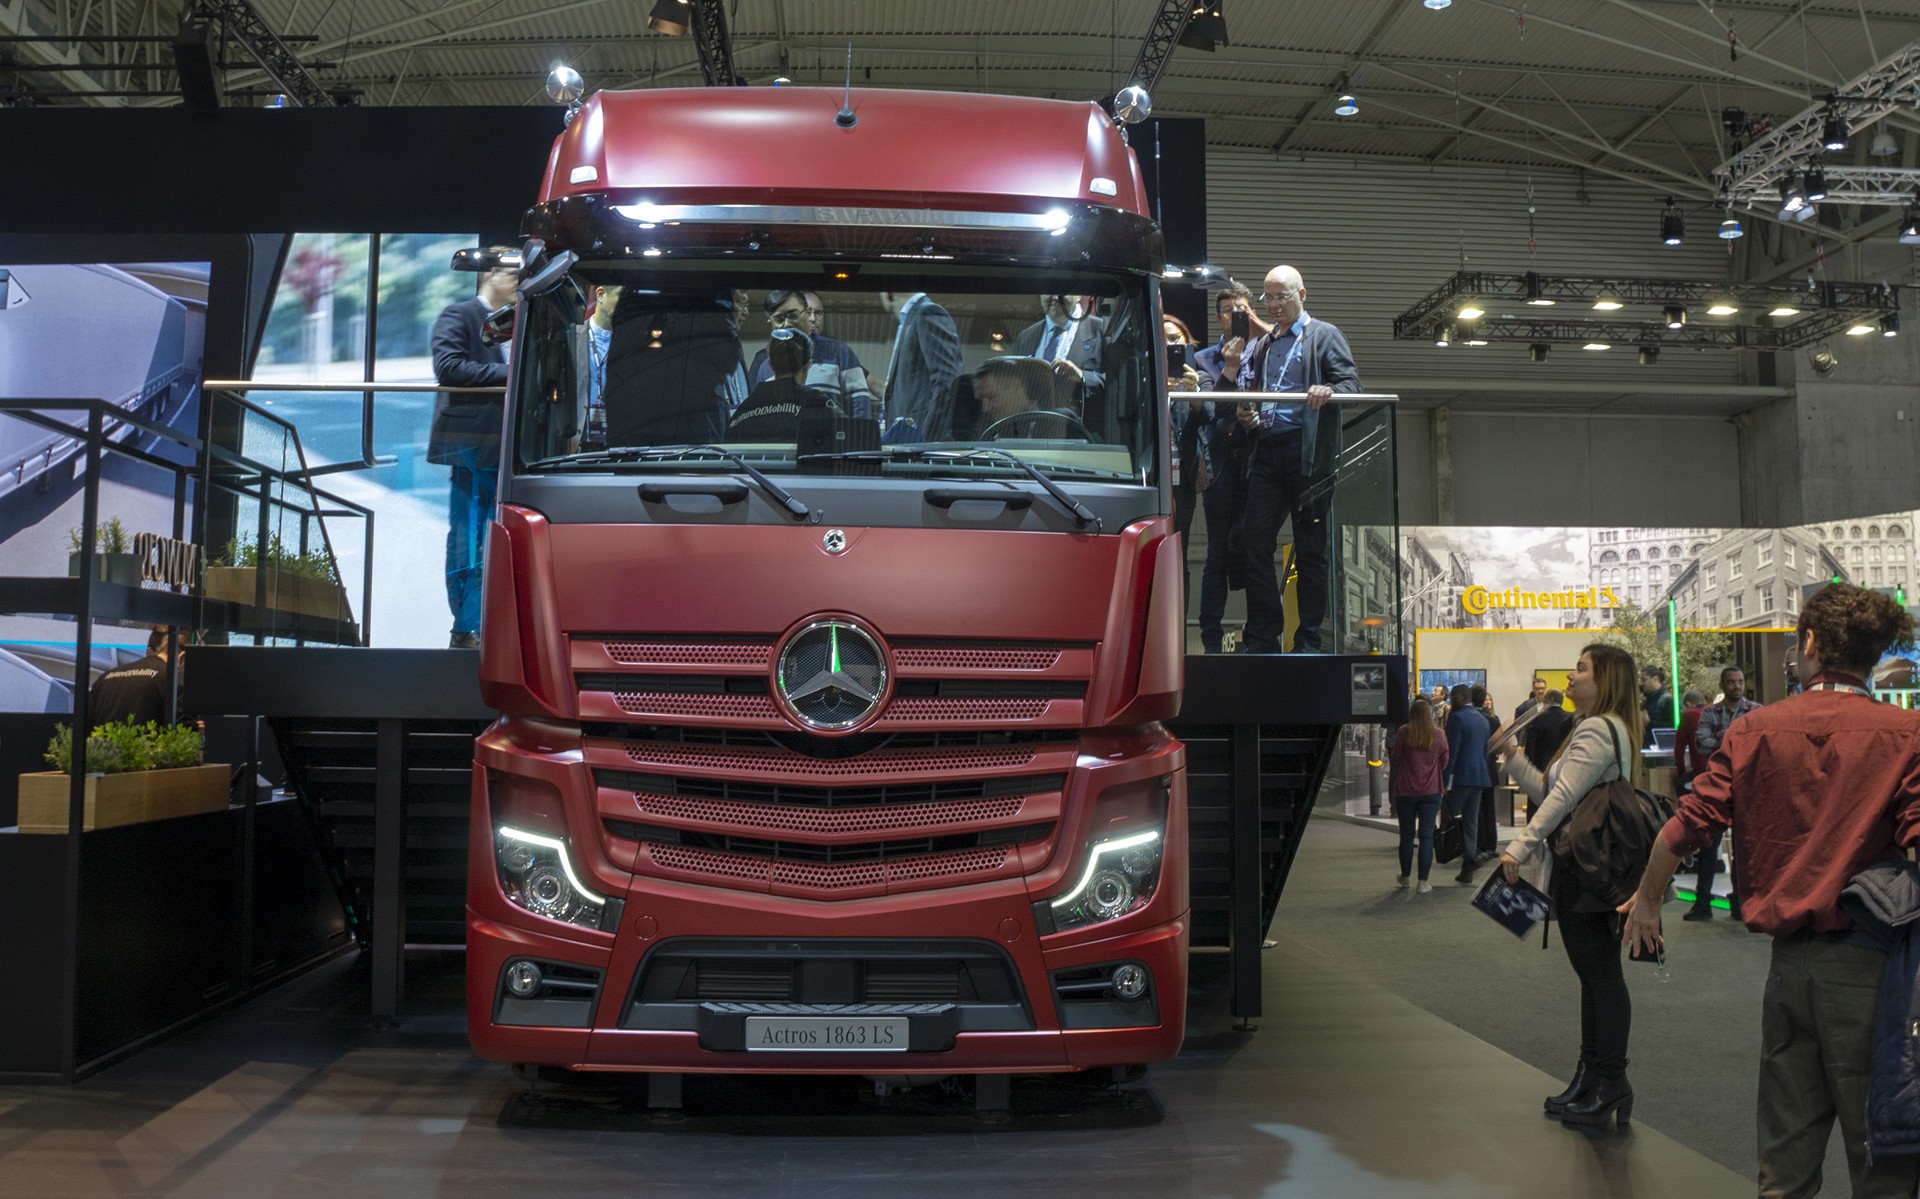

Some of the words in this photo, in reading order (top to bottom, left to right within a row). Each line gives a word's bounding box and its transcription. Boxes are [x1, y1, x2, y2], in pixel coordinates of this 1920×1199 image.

[1461, 584, 1598, 615] Continental
[762, 1025, 817, 1044] Actros
[825, 1025, 866, 1044] 1863
[873, 1025, 894, 1044] LS
